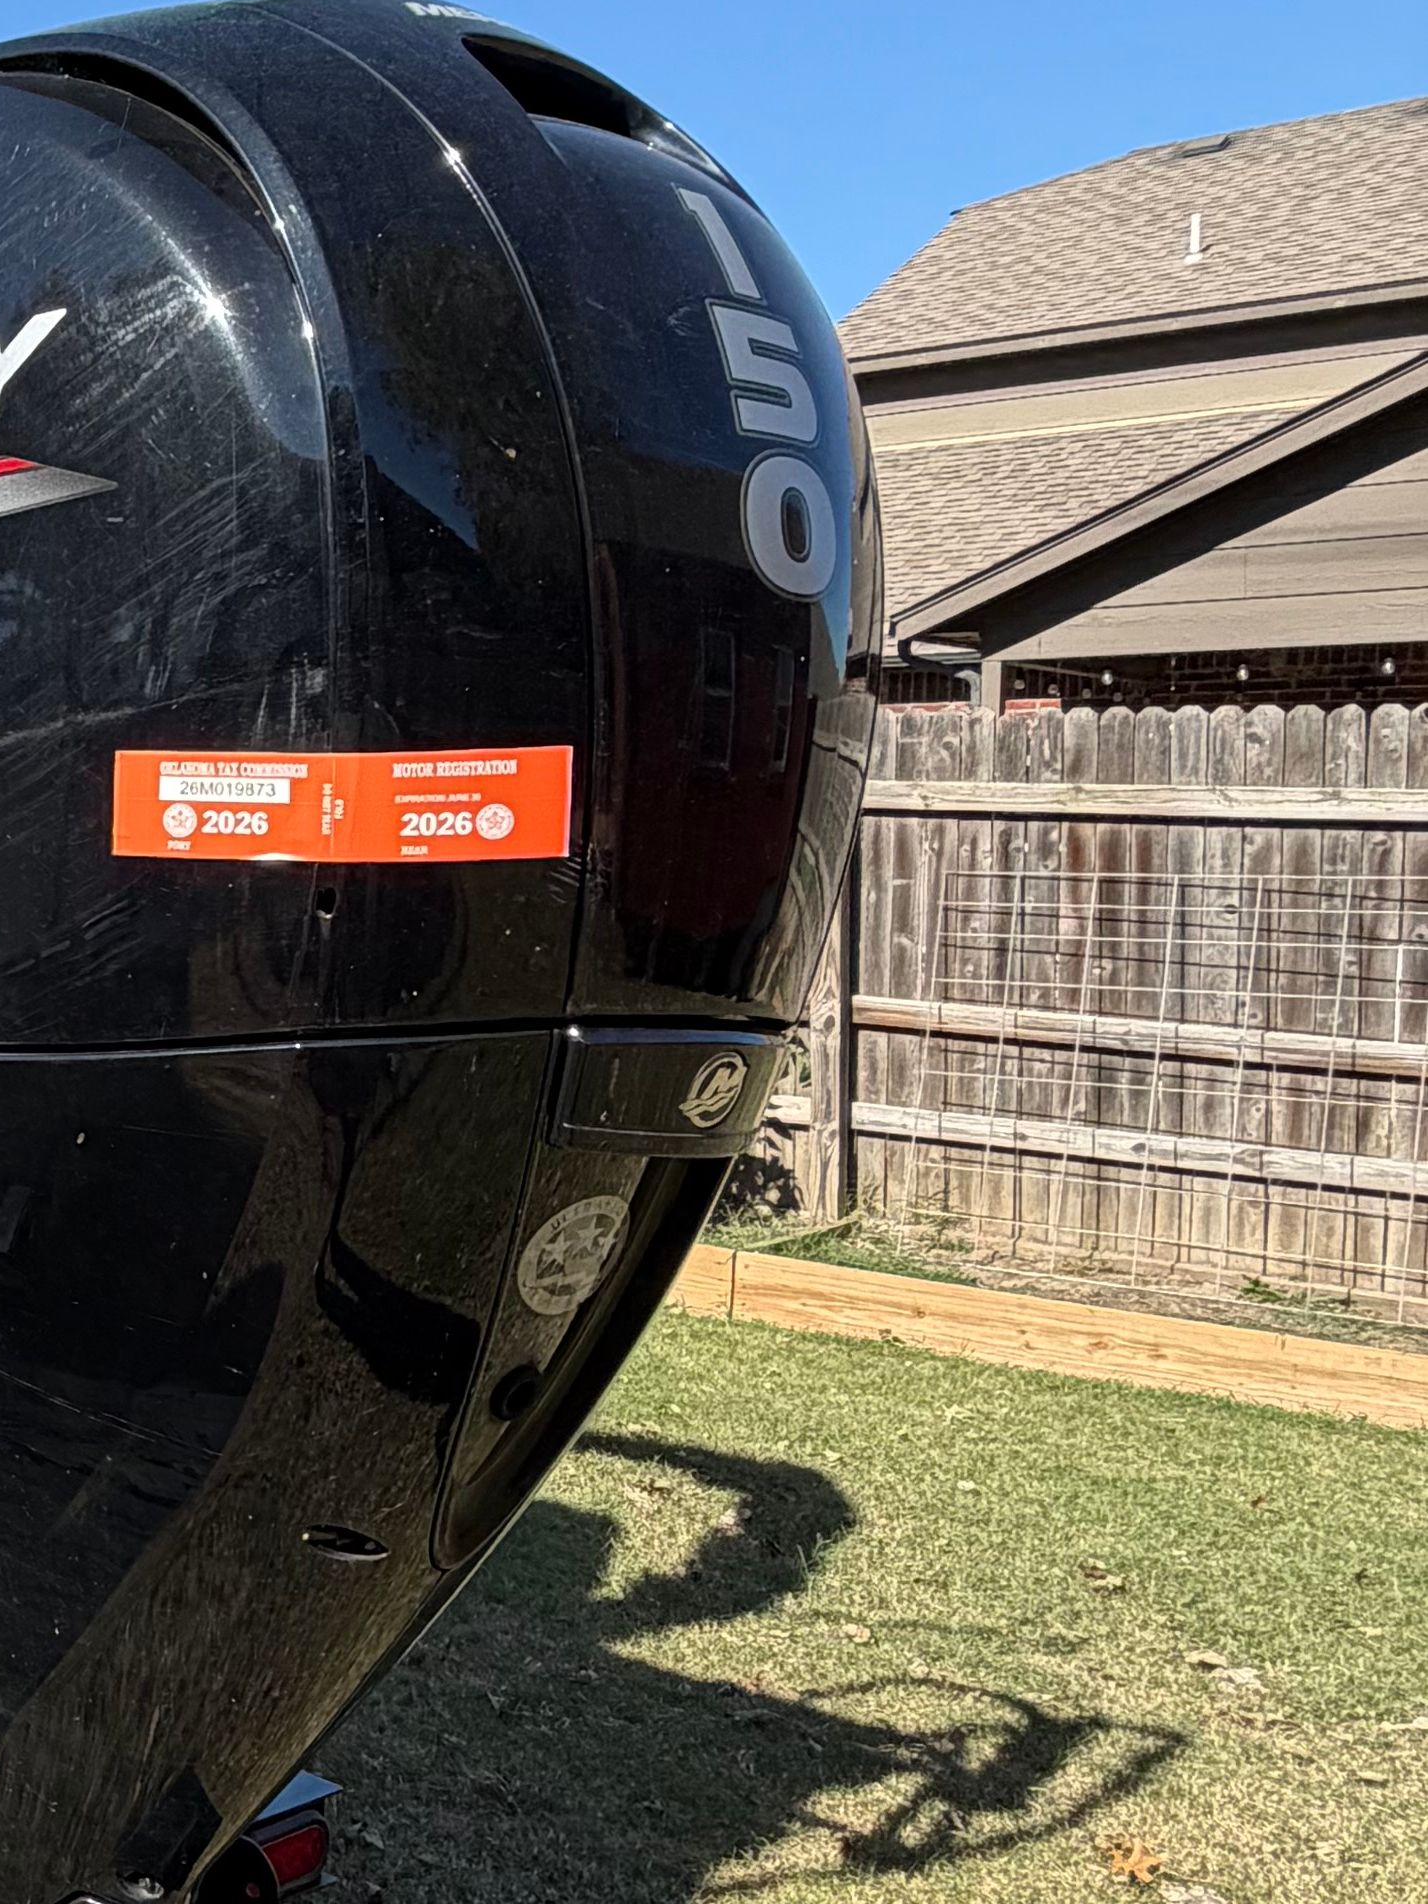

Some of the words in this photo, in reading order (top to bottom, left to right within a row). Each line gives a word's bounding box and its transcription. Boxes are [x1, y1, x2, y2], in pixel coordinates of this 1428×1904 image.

[672, 183, 838, 602] 150
[159, 761, 216, 775] OKLAHOMA
[217, 762, 239, 776] TAX
[240, 762, 308, 778] COMMISSION
[392, 763, 434, 778] MOTOR
[436, 759, 518, 777] REGISTRATION
[180, 781, 276, 797] 26M019873
[201, 810, 269, 835] 2026
[400, 811, 473, 837] 2026
